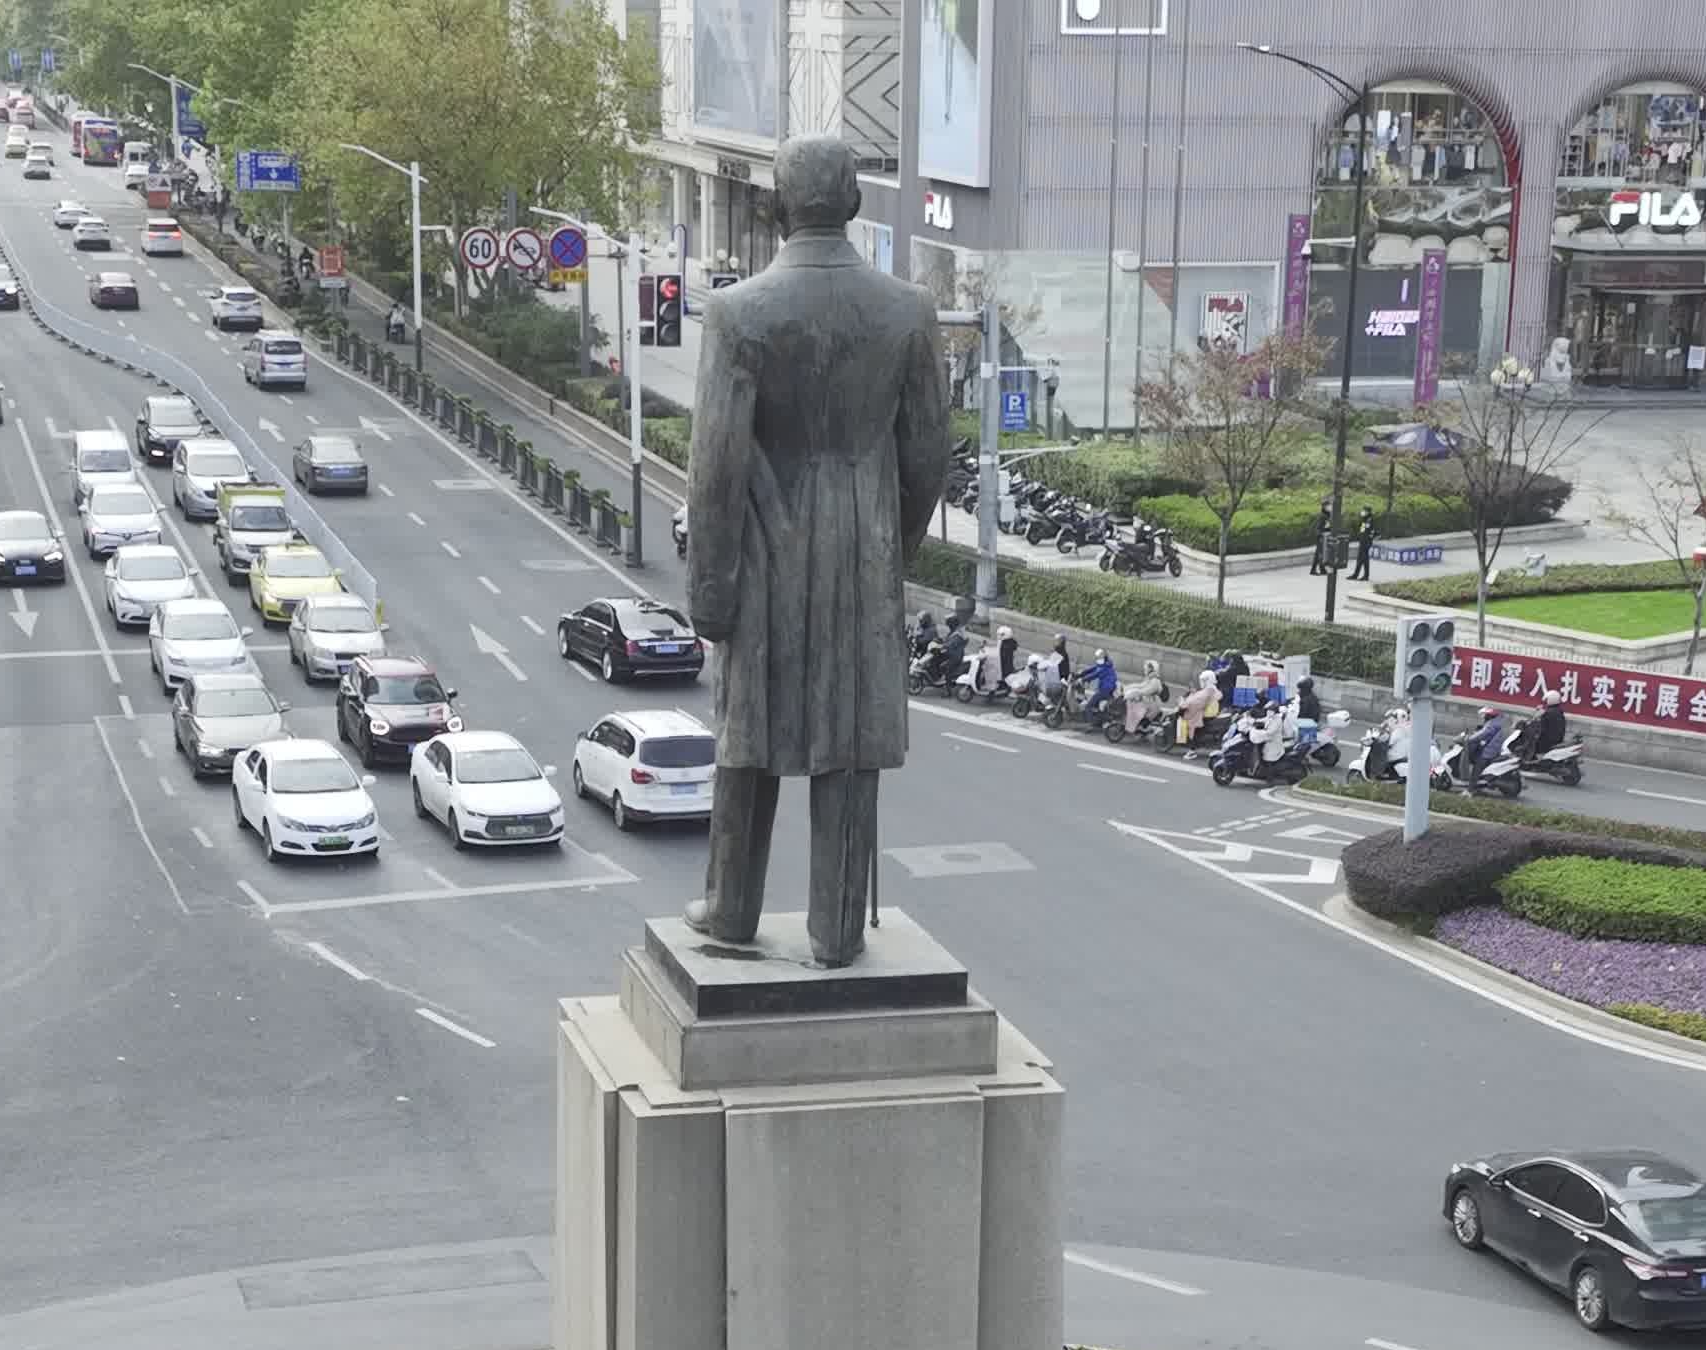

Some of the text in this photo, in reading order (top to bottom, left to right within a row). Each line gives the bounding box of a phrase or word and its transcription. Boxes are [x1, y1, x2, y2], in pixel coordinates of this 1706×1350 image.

[924, 191, 953, 230] FILA
[1609, 191, 1701, 226] FILA
[469, 239, 492, 259] 60
